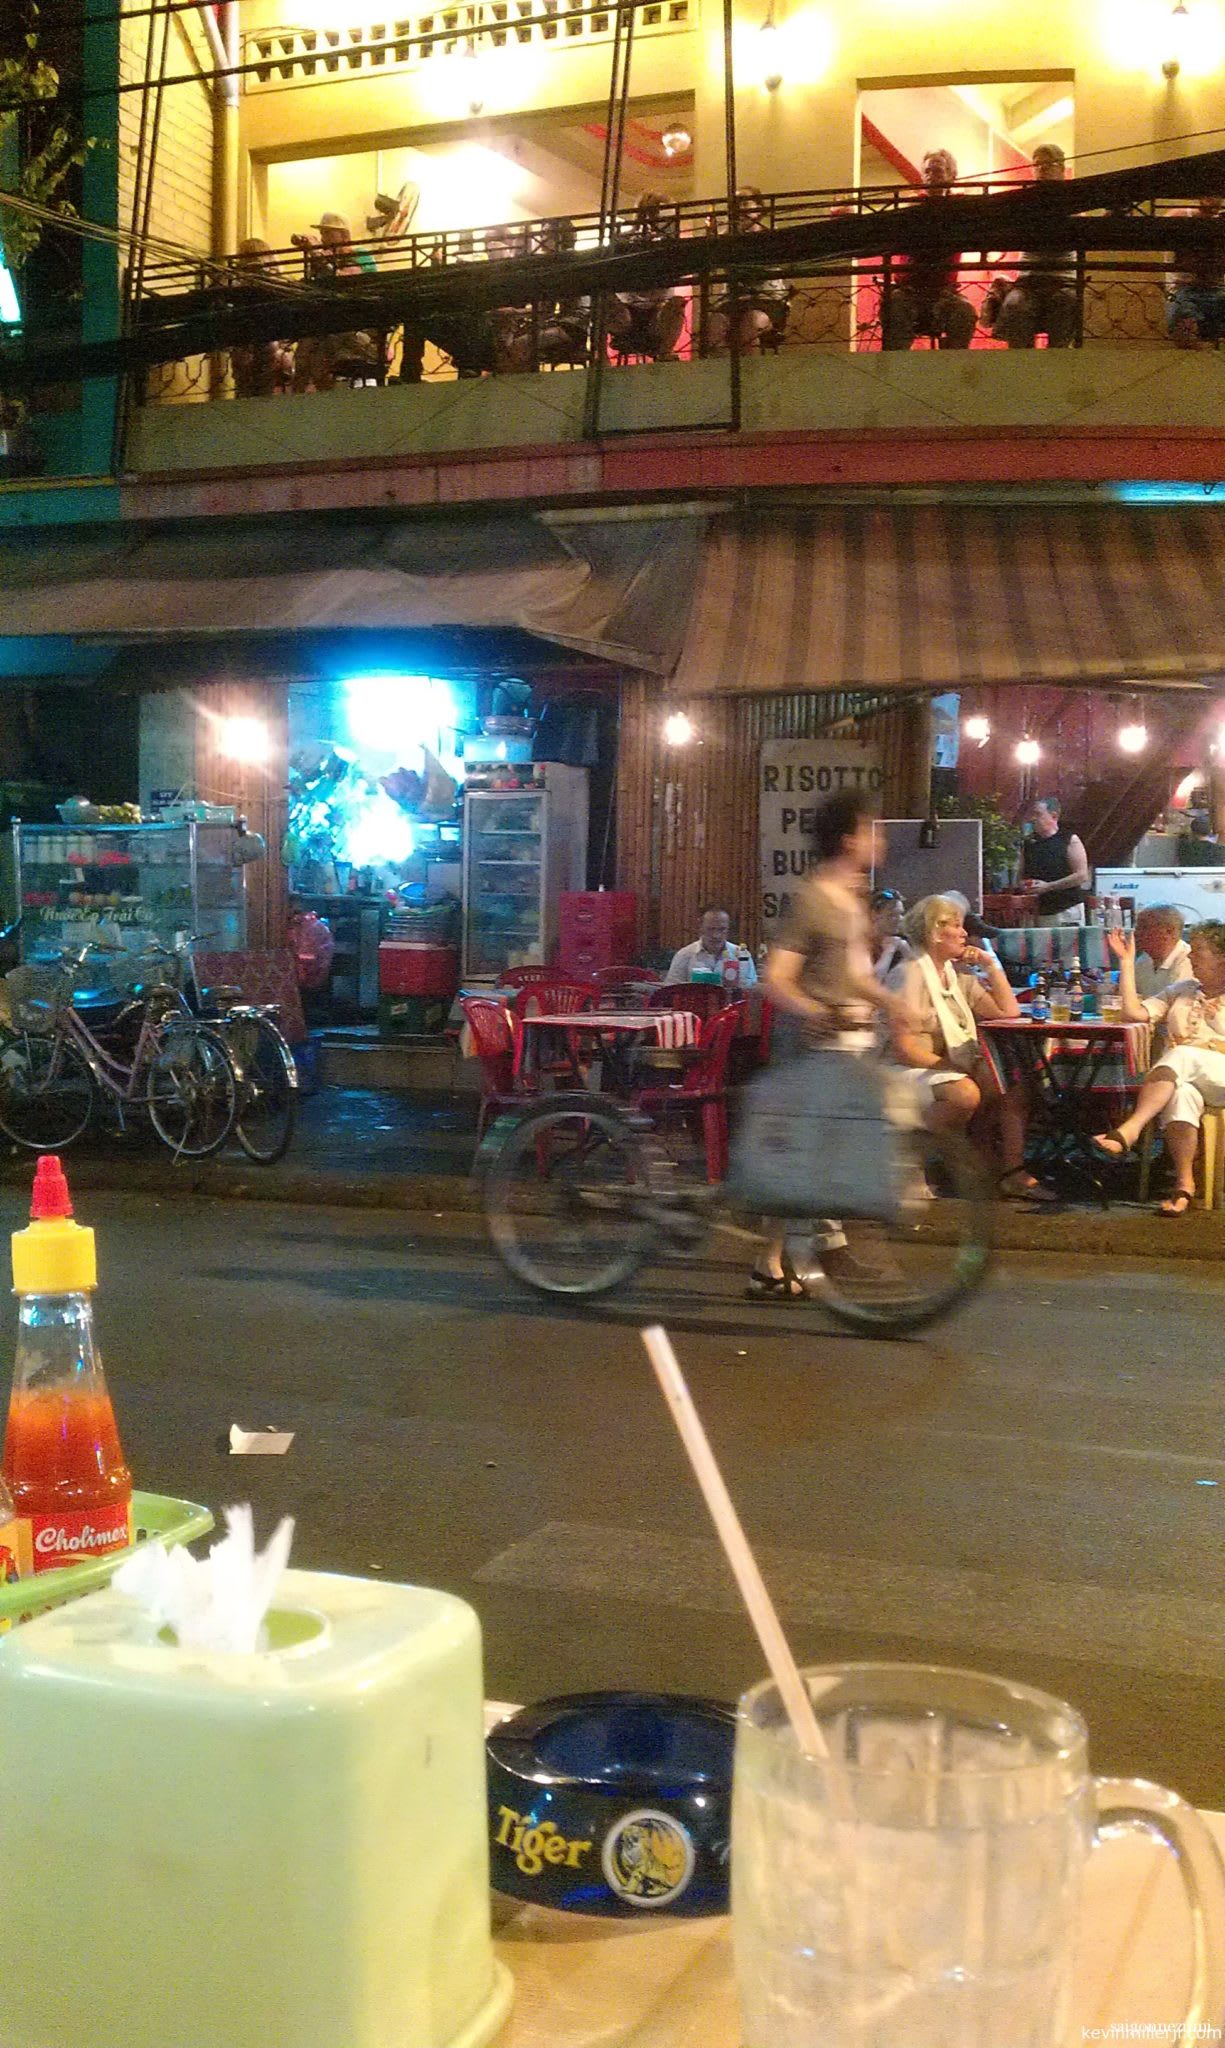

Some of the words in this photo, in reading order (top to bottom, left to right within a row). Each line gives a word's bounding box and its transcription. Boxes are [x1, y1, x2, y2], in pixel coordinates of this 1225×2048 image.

[764, 765, 882, 792] RISOTTO
[35, 1523, 128, 1553] Cholimex
[495, 1805, 593, 1875] Tiger
